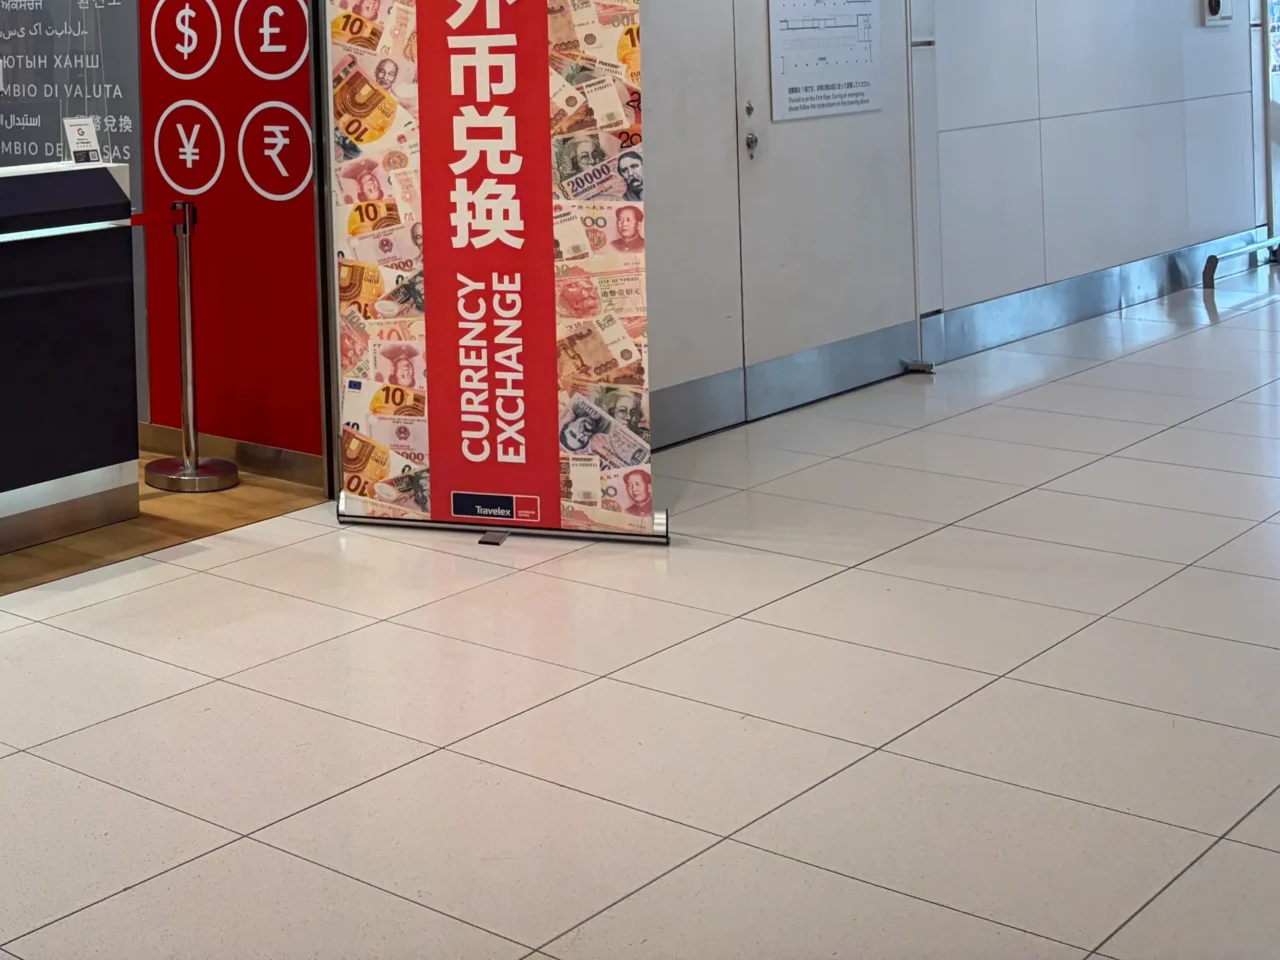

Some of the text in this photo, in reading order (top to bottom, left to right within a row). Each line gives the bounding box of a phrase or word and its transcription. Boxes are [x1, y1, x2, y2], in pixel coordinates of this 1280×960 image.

[341, 14, 364, 36] 10
[53, 54, 100, 69] ХАНШ
[43, 84, 59, 98] DI
[65, 84, 123, 99] VALUTA
[5, 114, 41, 130] استبدال
[618, 131, 642, 149] 20
[44, 142, 63, 157] DE
[354, 203, 378, 223] 10
[457, 272, 491, 462] CURRENCY
[492, 272, 526, 464] EXCHANGE
[382, 386, 405, 406] 10
[475, 505, 511, 516] Travelex
